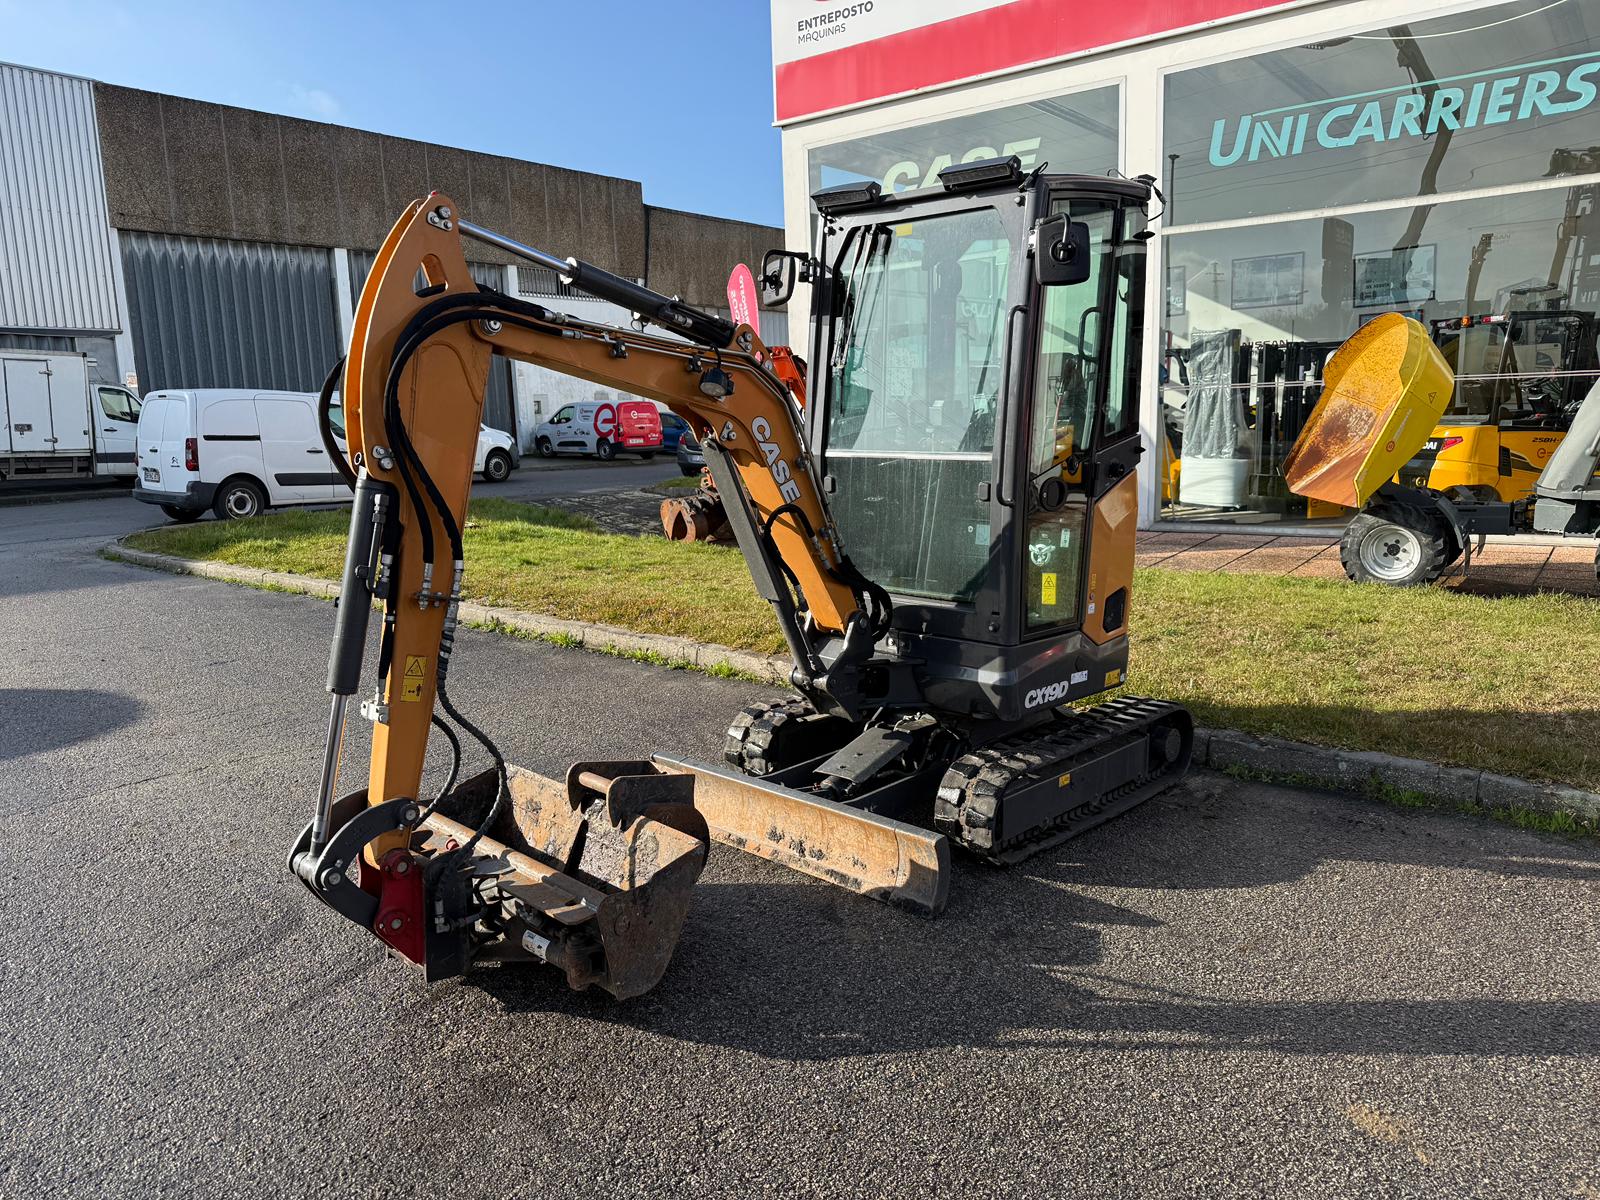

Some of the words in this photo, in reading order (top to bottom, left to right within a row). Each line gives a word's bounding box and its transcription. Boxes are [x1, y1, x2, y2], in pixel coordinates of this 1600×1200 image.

[797, 1, 874, 32] ENTREPOSTO
[798, 22, 846, 44] MÁQUINAS
[751, 416, 801, 504] CASE
[1024, 680, 1069, 709] CX19D
